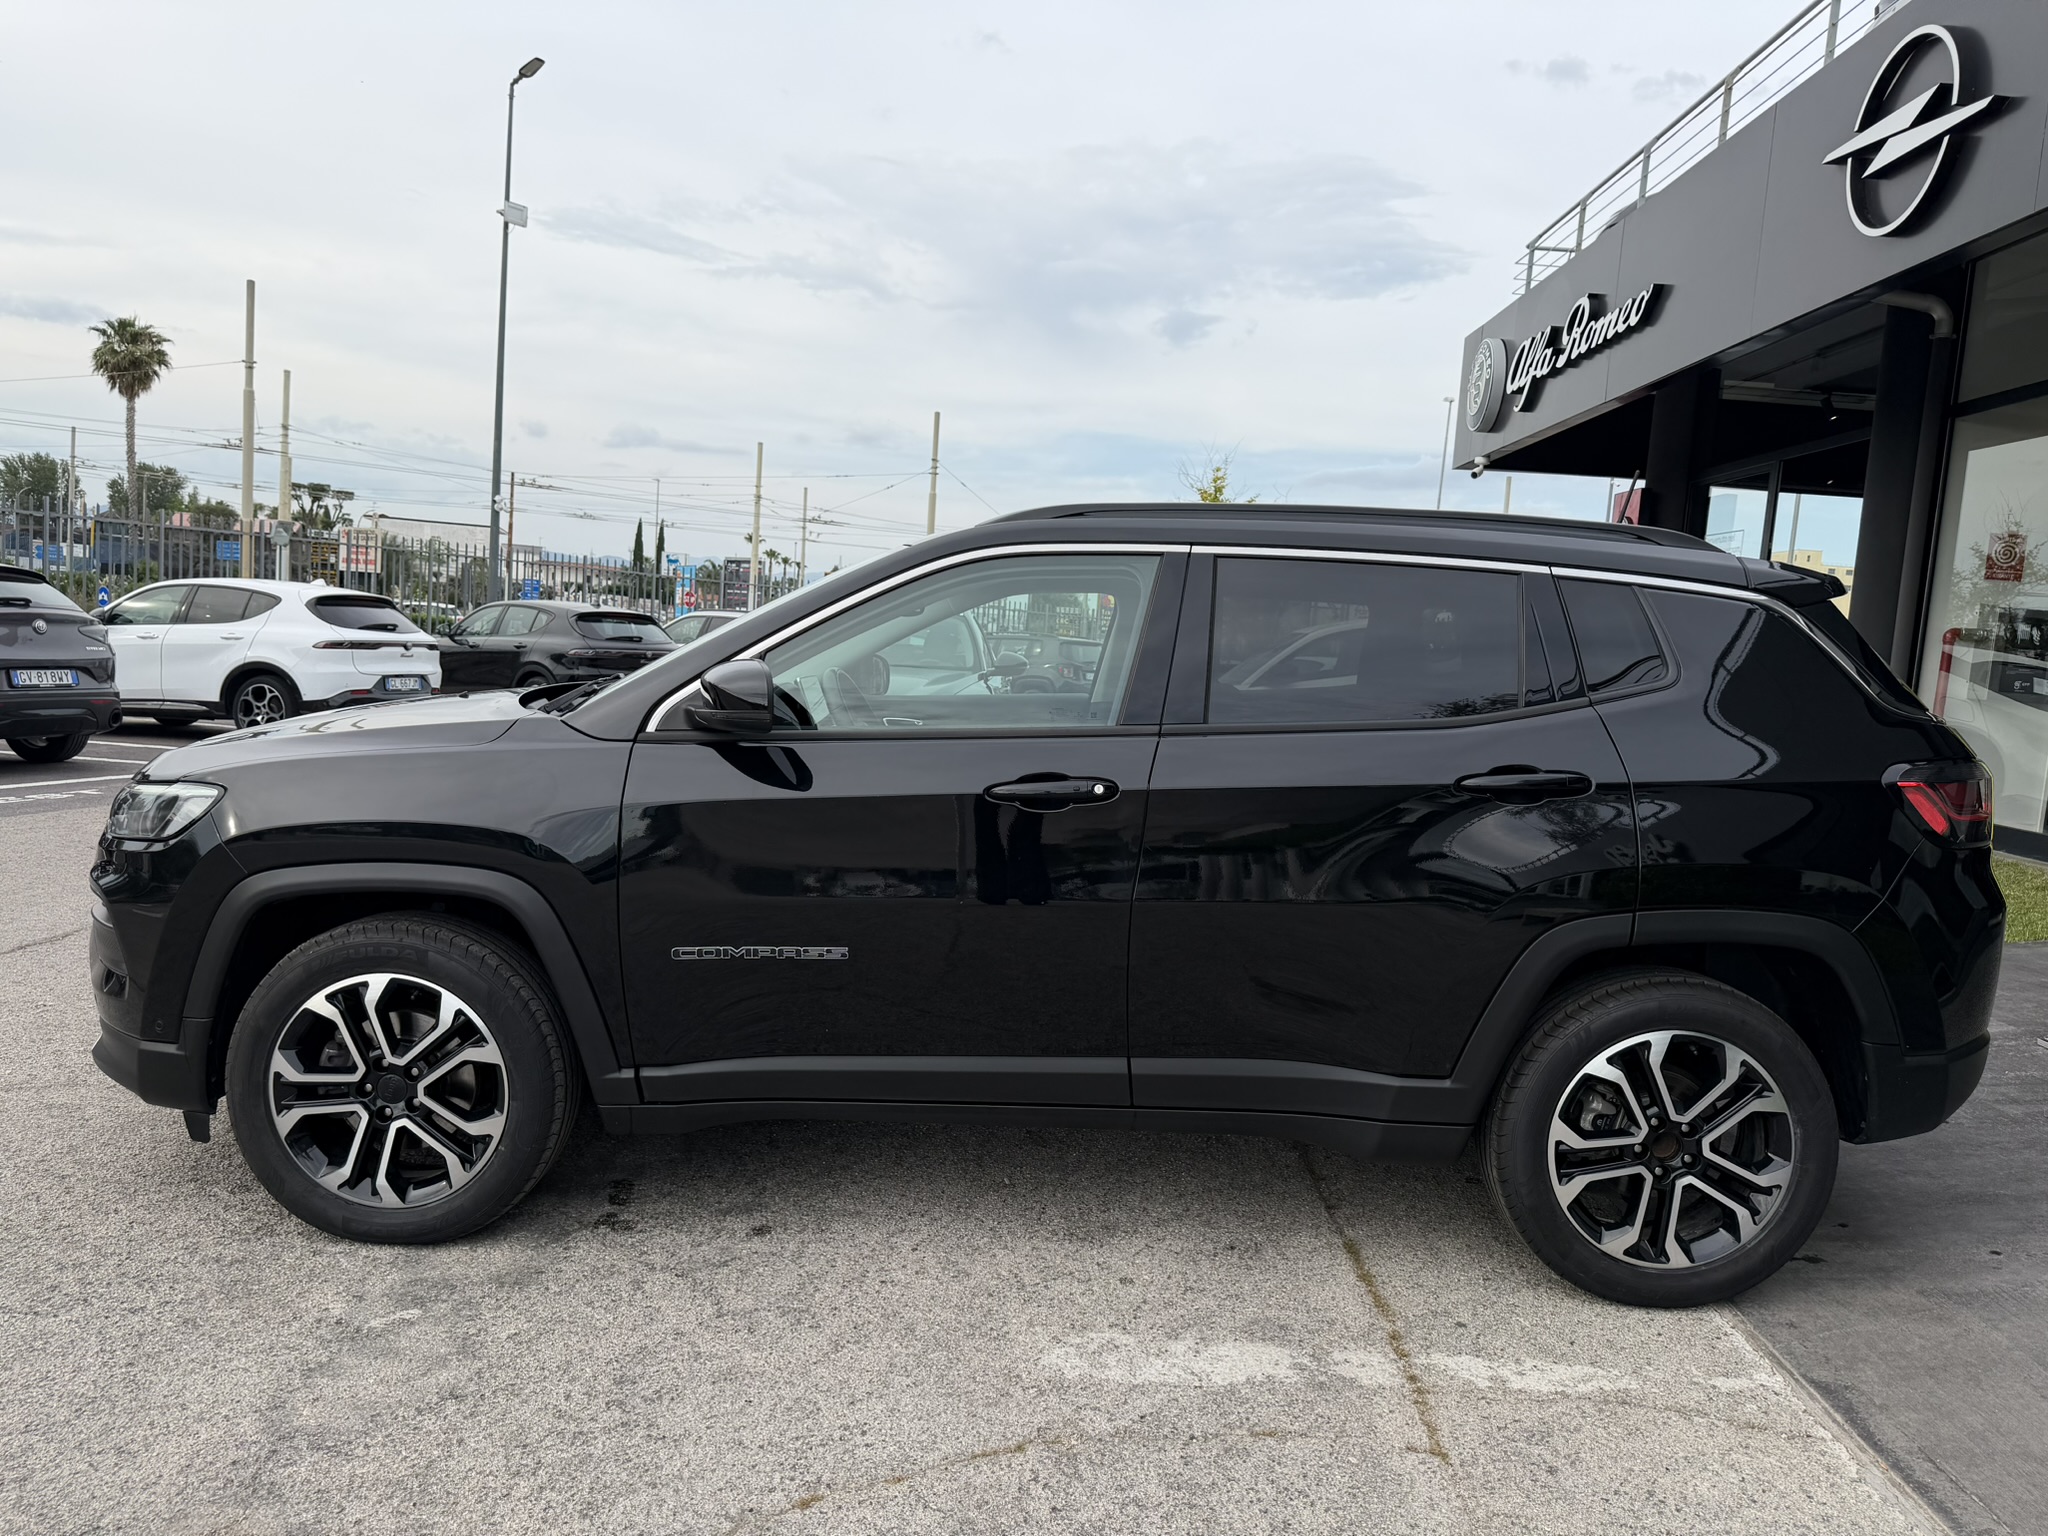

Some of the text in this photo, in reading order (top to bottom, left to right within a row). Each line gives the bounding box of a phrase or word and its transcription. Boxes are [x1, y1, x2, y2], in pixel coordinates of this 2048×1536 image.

[1506, 325, 1556, 413] Alfa
[1556, 283, 1654, 368] Romeo
[334, 946, 419, 963] FULDA
[671, 946, 849, 960] COMPASS
